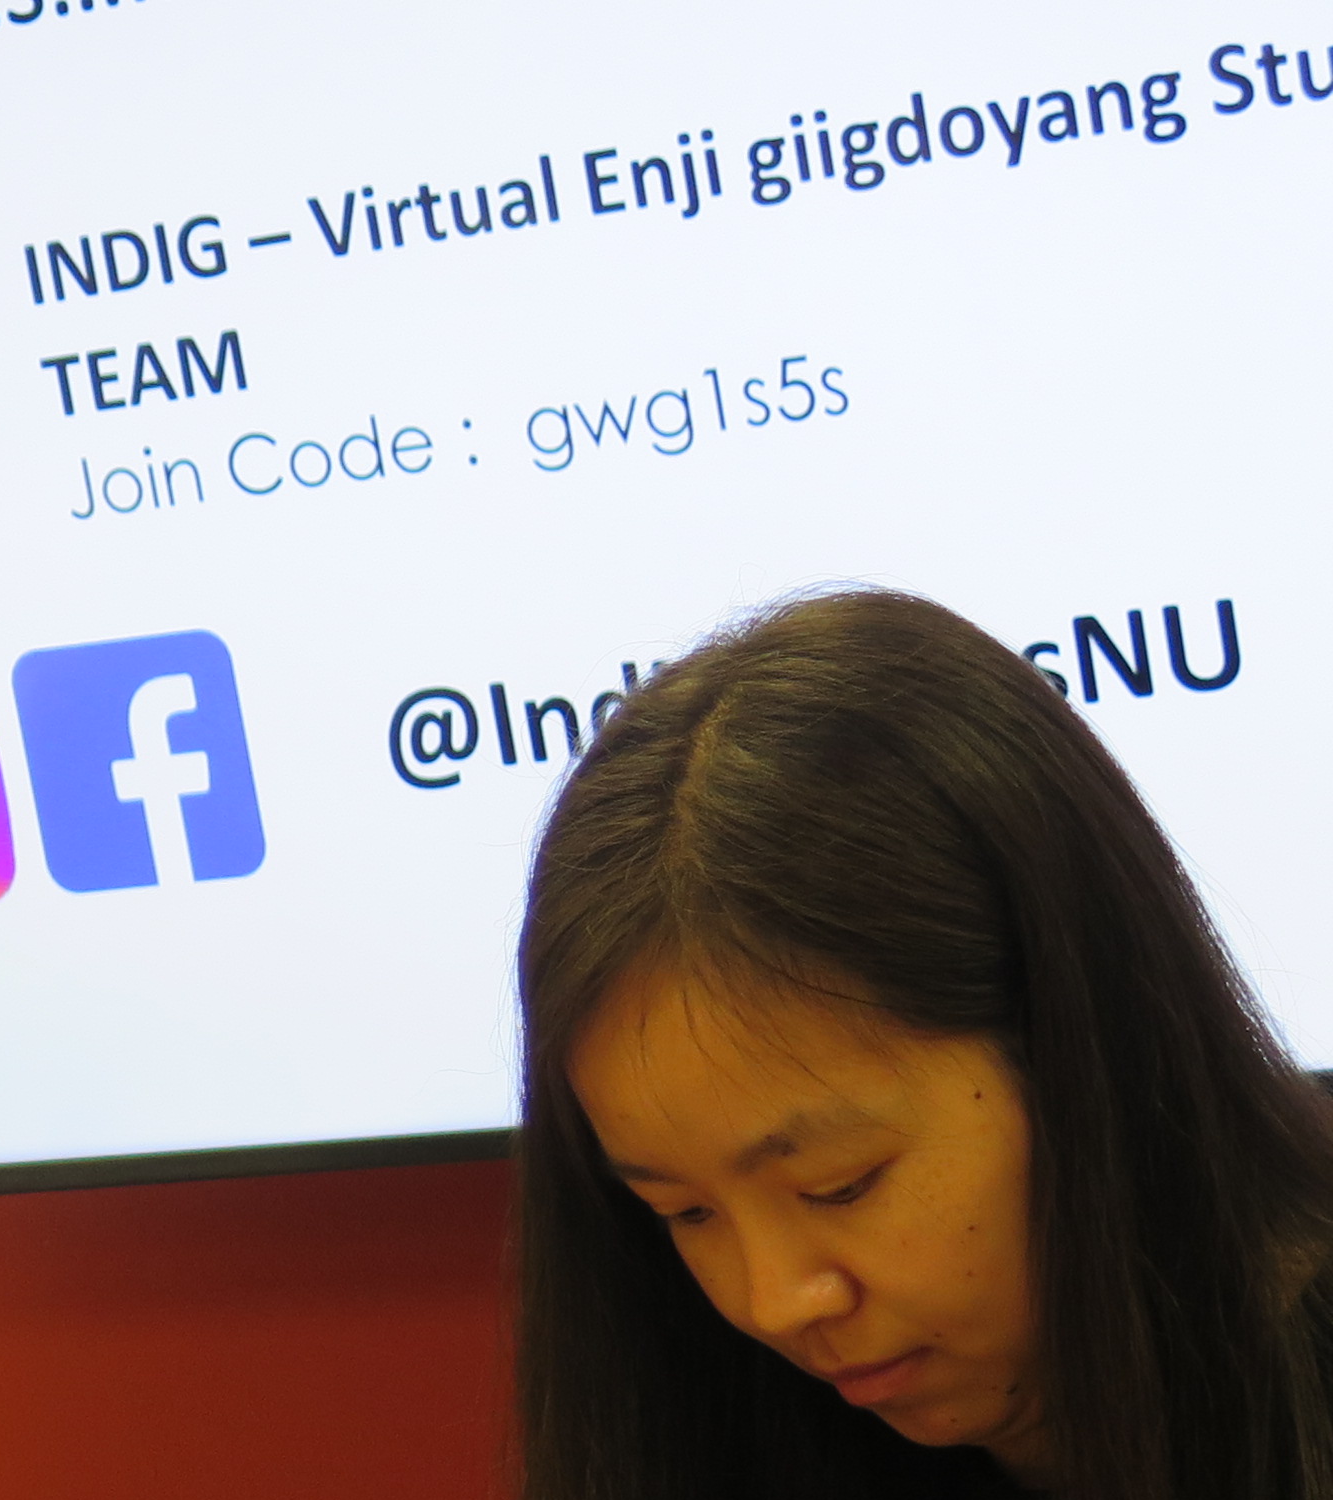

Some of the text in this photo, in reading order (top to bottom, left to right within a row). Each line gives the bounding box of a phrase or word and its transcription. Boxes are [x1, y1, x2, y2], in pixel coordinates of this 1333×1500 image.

[23, 215, 228, 305] INDIG
[307, 154, 561, 257] Virtual
[584, 129, 723, 218] Enji
[746, 71, 1187, 205] giigdoyang
[1208, 43, 1333, 114] Stu
[39, 329, 248, 417] TEAM
[71, 446, 204, 520] Join
[228, 416, 433, 496] Code
[526, 355, 850, 471] gwg1s5s
